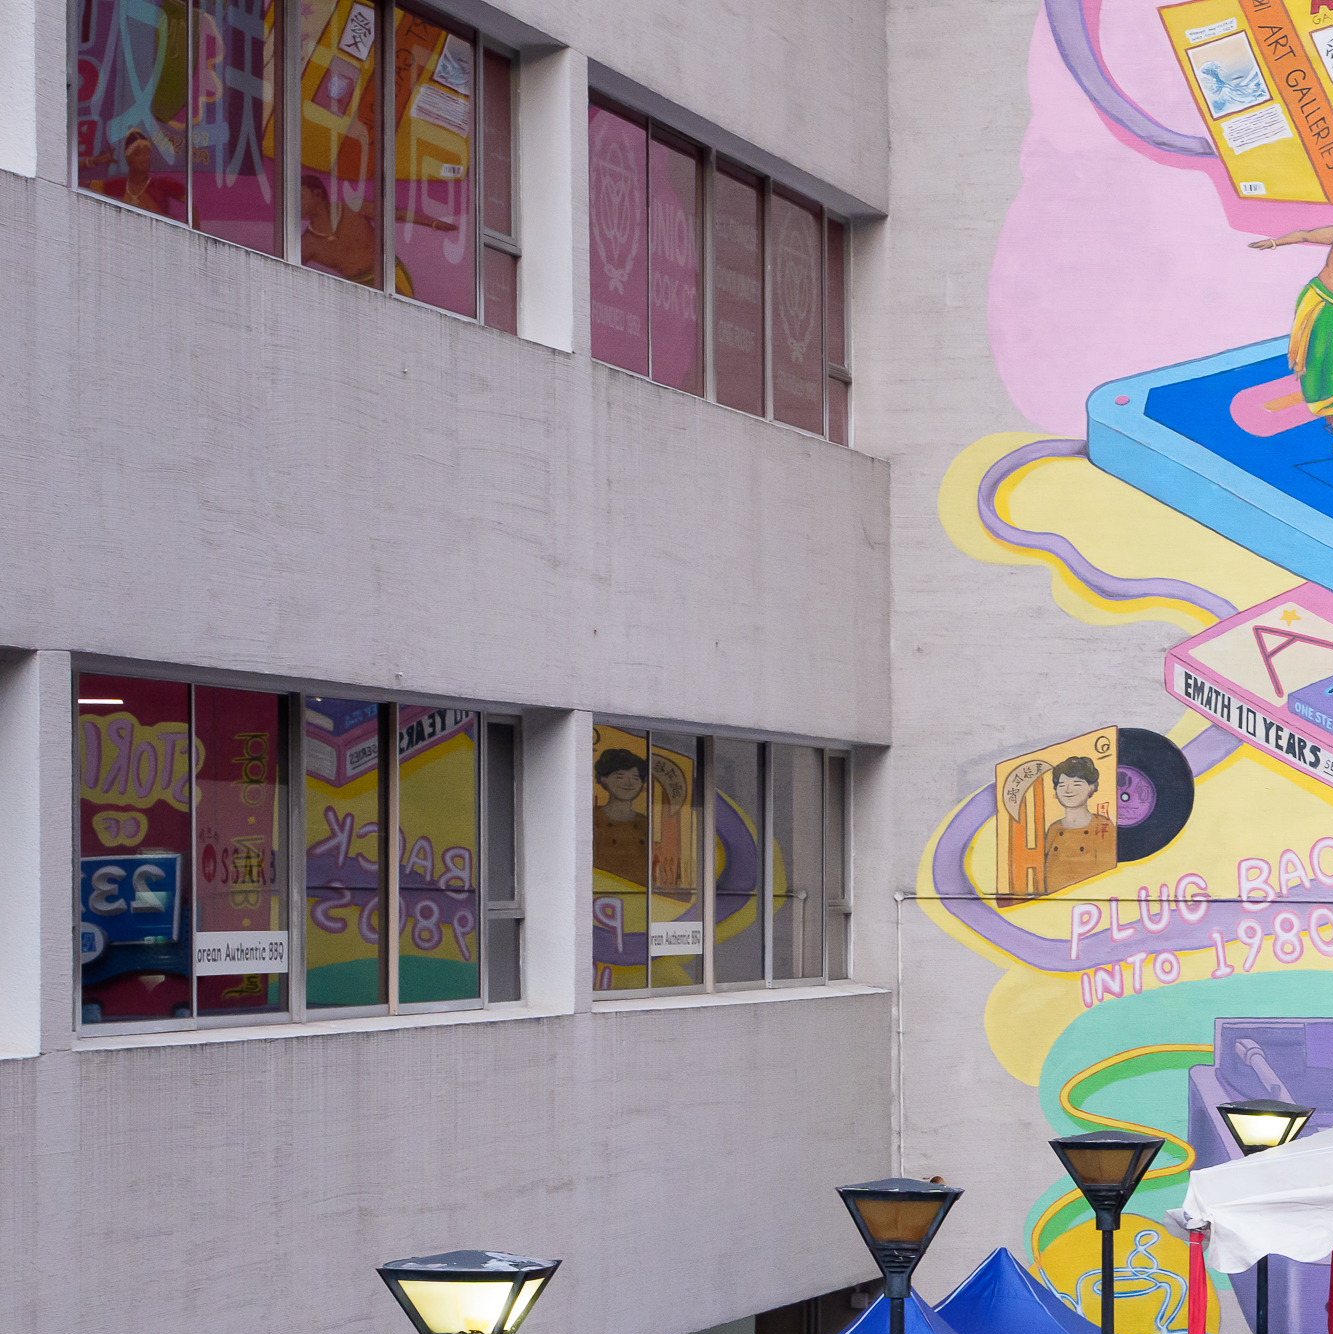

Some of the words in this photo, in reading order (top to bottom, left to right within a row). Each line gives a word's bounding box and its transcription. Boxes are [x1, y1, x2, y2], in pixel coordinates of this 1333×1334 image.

[1258, 25, 1296, 61] ART
[1184, 670, 1231, 722] EMATH
[1236, 705, 1257, 738] 10
[1262, 716, 1322, 770] YEARS
[1294, 702, 1315, 720] ONE
[1069, 873, 1211, 960] PLUG
[224, 941, 266, 963] Authentic
[269, 940, 284, 962] BBQ
[1080, 950, 1181, 1008] INTO
